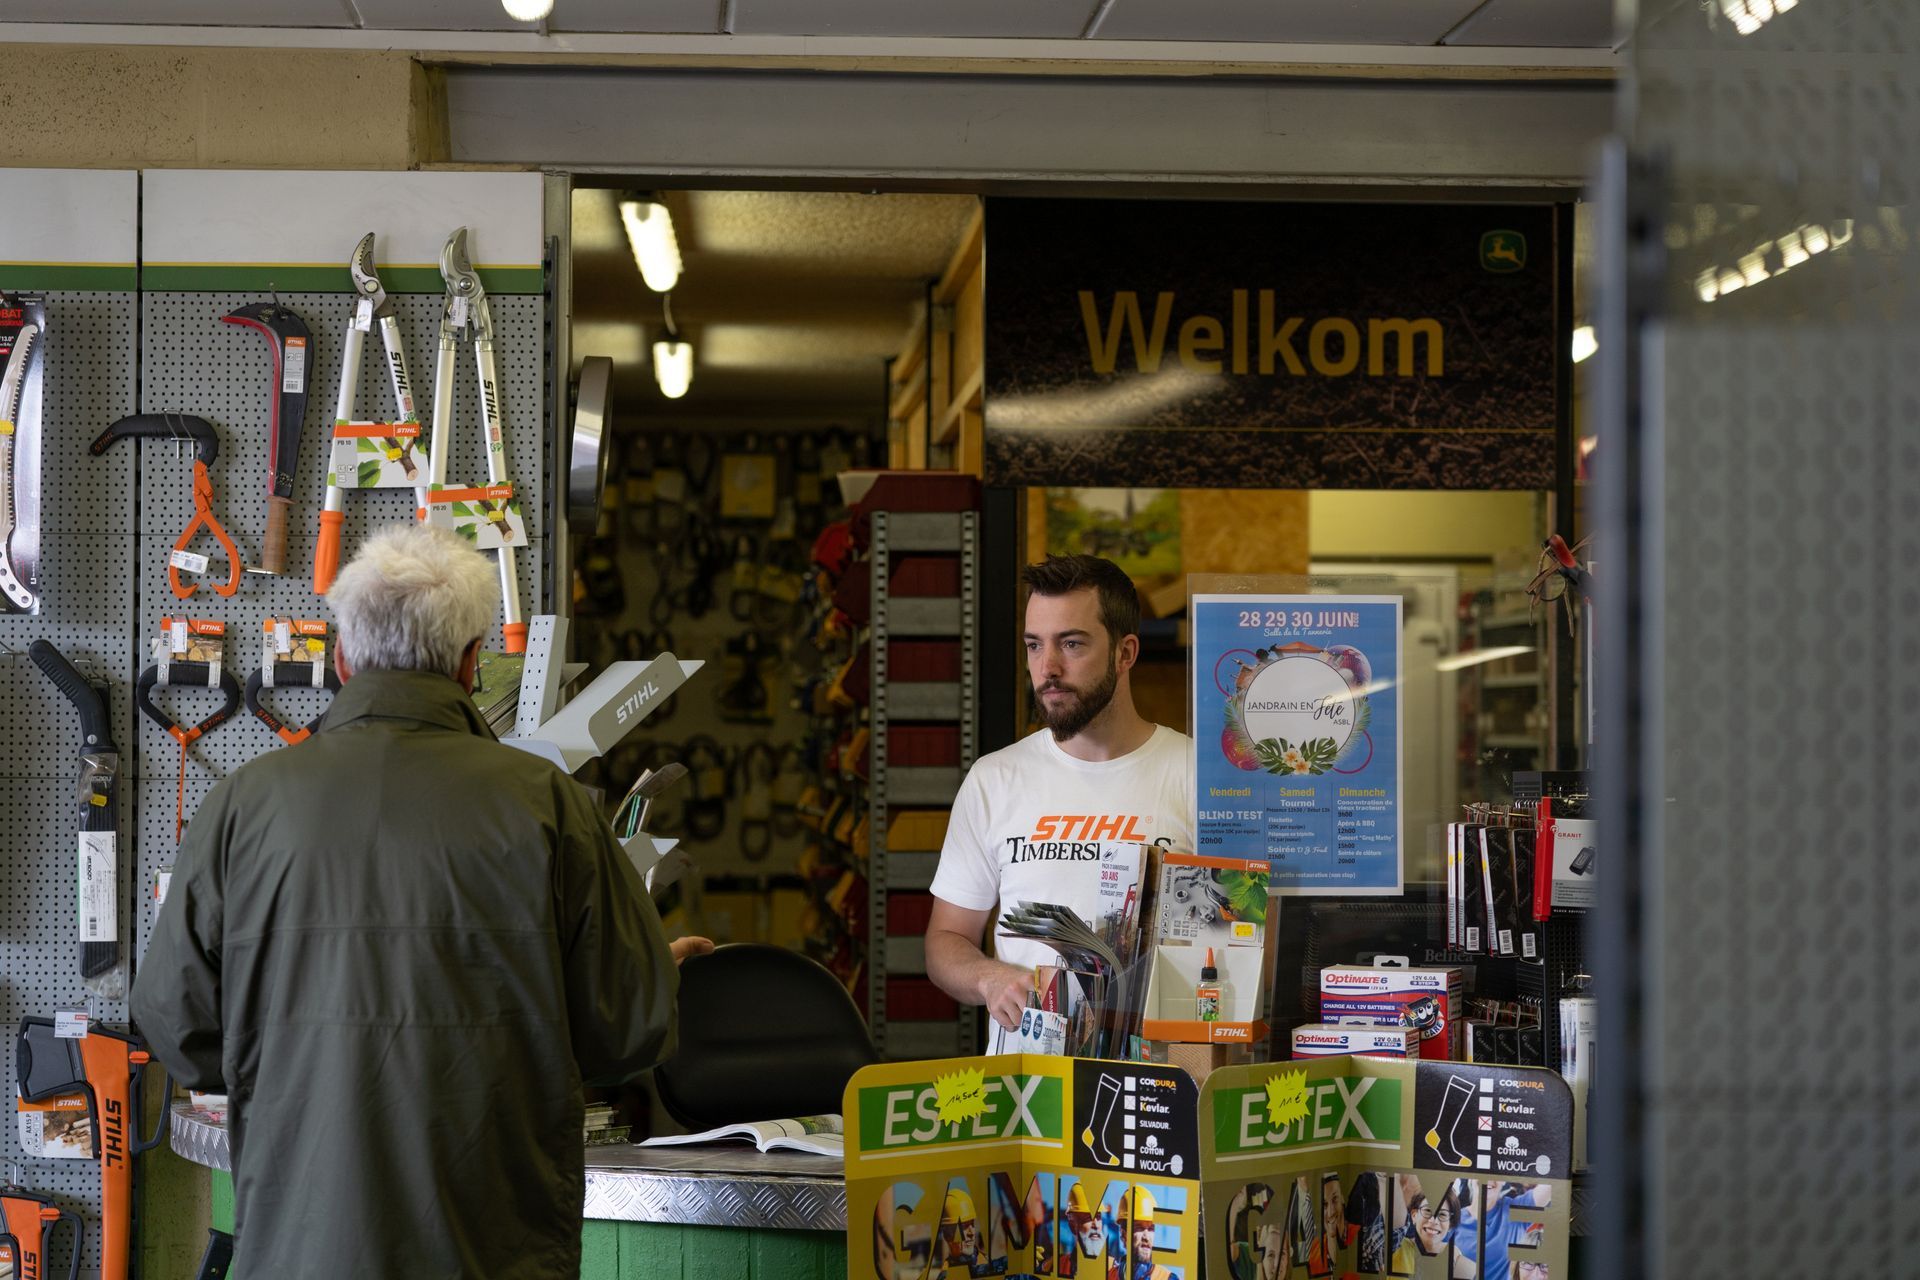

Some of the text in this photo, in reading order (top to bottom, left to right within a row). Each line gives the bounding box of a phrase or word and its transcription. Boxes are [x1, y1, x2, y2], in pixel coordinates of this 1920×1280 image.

[1078, 288, 1444, 377] Welkom
[391, 351, 408, 394] STIHL
[484, 379, 498, 424] STIHL
[95, 432, 113, 451] STIHL
[1239, 611, 1353, 628] 28 29 30 JUIN
[200, 624, 222, 632] STIHL
[303, 624, 324, 632] STIHL
[163, 638, 169, 647] FP
[616, 681, 660, 725] STIHL
[1247, 701, 1298, 711] JANDRAIN
[1300, 701, 1314, 710] EN
[202, 714, 226, 732] STIHL
[257, 708, 279, 730] STIHL
[1209, 787, 1251, 797] Vendredi
[1280, 787, 1315, 797] Samedi
[1339, 788, 1386, 798] Dimanche
[1281, 800, 1315, 808] Tournoi
[1199, 810, 1263, 820] BLIND TEST
[1030, 815, 1147, 842] STIHL
[1007, 836, 1173, 863] TIMBERSS
[1101, 870, 1119, 881] 30 ANS
[1214, 1027, 1248, 1037] STIHL
[1424, 1022, 1443, 1038] CARE
[1339, 1036, 1349, 1044] 3
[1140, 1078, 1177, 1088] CORDURA
[1499, 1079, 1545, 1090] CORDURA
[57, 1099, 83, 1107] STIHL
[883, 1075, 1044, 1145] ESEX
[25, 1125, 32, 1134] AX
[1139, 1120, 1169, 1130] SILVADUR
[1497, 1121, 1534, 1130] SILVADUR
[105, 1098, 121, 1167] STIHL
[1139, 1145, 1165, 1156] COTTON
[1497, 1146, 1528, 1156] COTTON
[1139, 1159, 1165, 1171] WOOL
[1497, 1160, 1528, 1171] WOOL
[873, 1172, 1188, 1280] GAMME
[1226, 1172, 1552, 1280] GAMME
